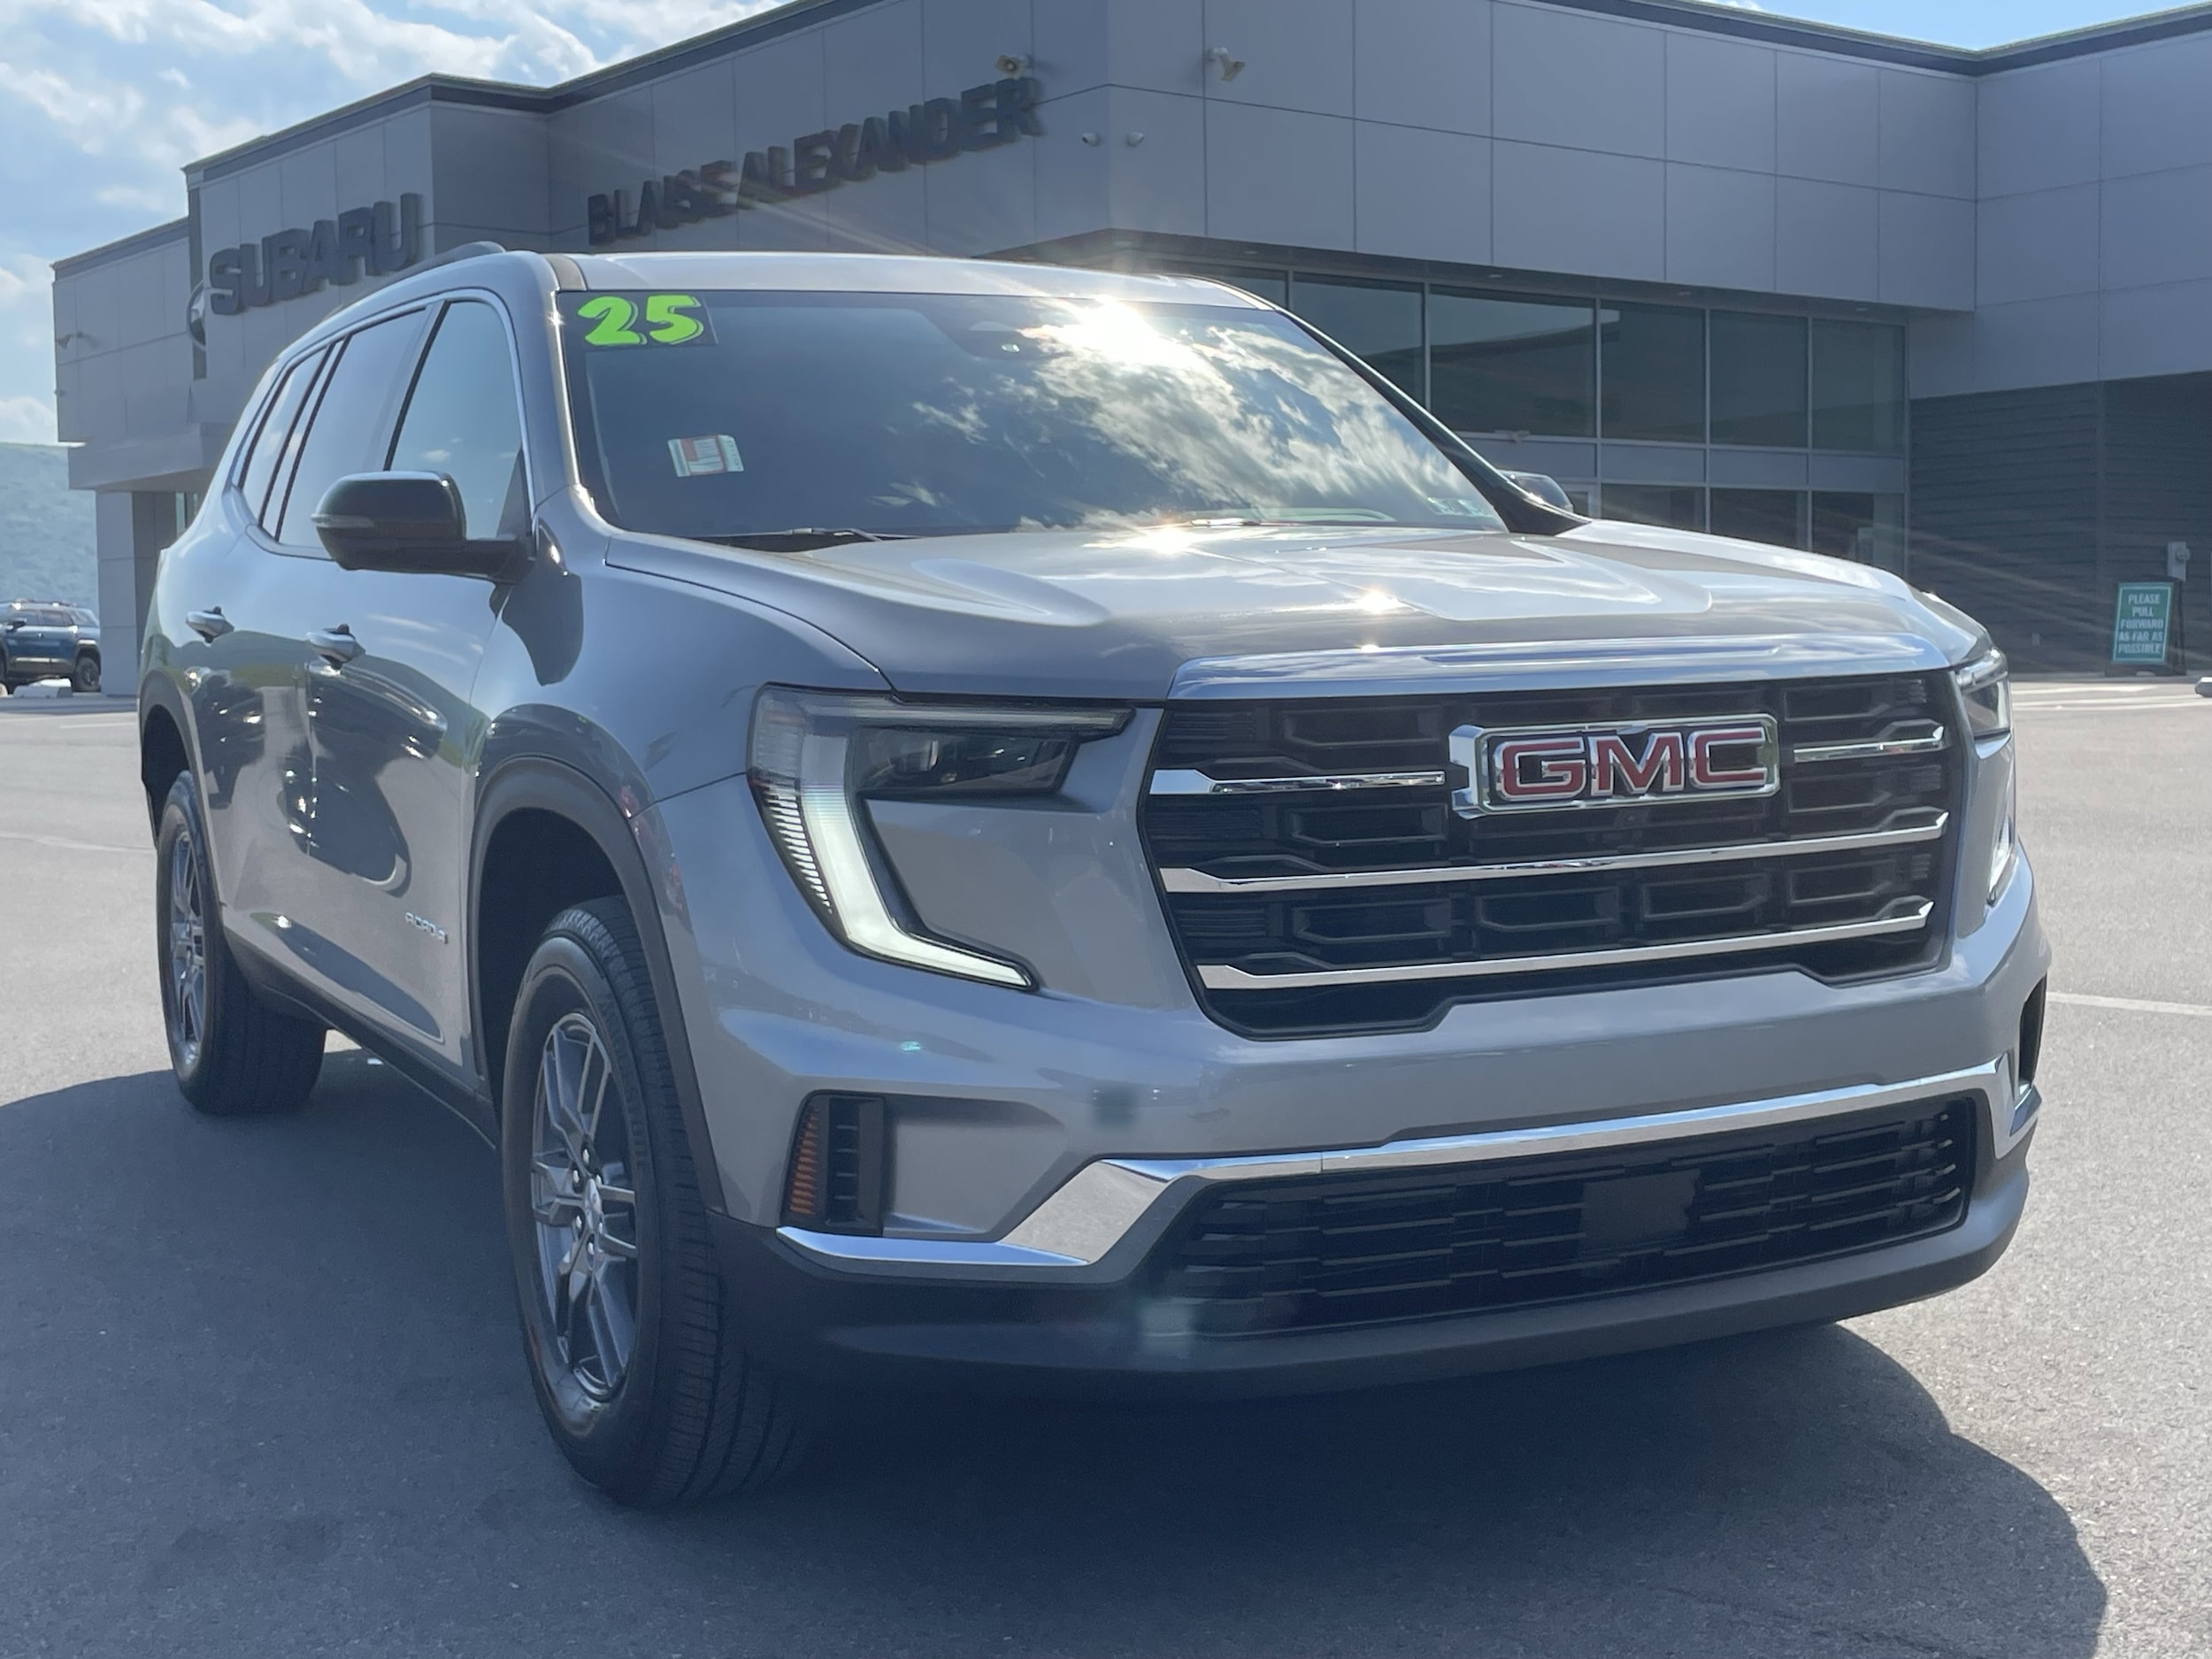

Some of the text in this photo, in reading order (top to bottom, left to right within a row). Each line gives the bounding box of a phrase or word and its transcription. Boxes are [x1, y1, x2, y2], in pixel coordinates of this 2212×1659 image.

[588, 76, 1044, 246] BLAISE ALEXANDER
[209, 192, 420, 316] SUBARU
[577, 295, 704, 346] 25
[2127, 594, 2161, 604] PLEASE
[2131, 606, 2154, 617] PULL
[2120, 618, 2164, 630] FORWARD
[2118, 631, 2163, 641] AS FAR AS
[2117, 643, 2162, 654] POSSIBLE
[1494, 726, 1768, 802] GMC
